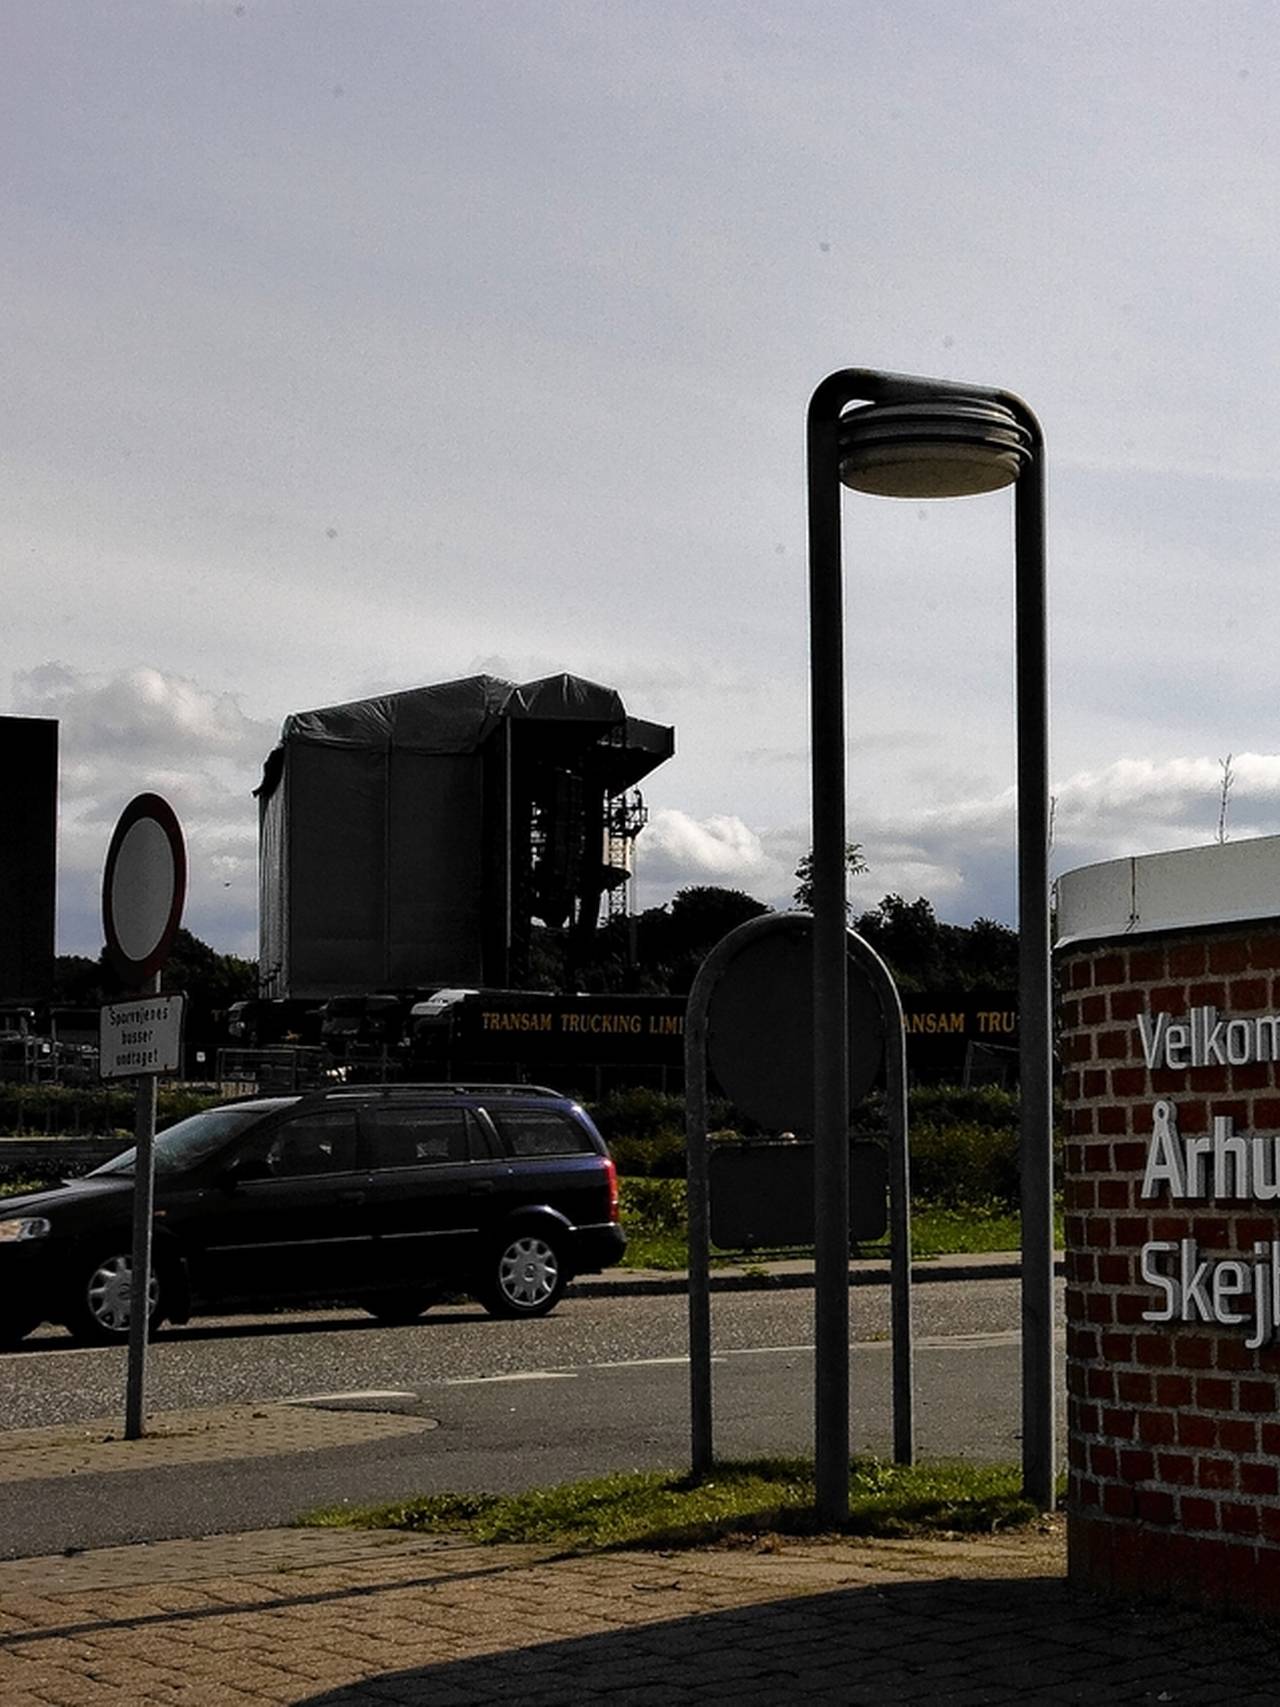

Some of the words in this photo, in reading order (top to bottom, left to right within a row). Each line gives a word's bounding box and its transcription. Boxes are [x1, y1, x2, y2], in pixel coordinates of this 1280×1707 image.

[482, 1012, 552, 1031] TRANSAM
[560, 1013, 642, 1033] TRUCKING
[976, 1011, 1020, 1033] TRU
[121, 1030, 153, 1045] busser
